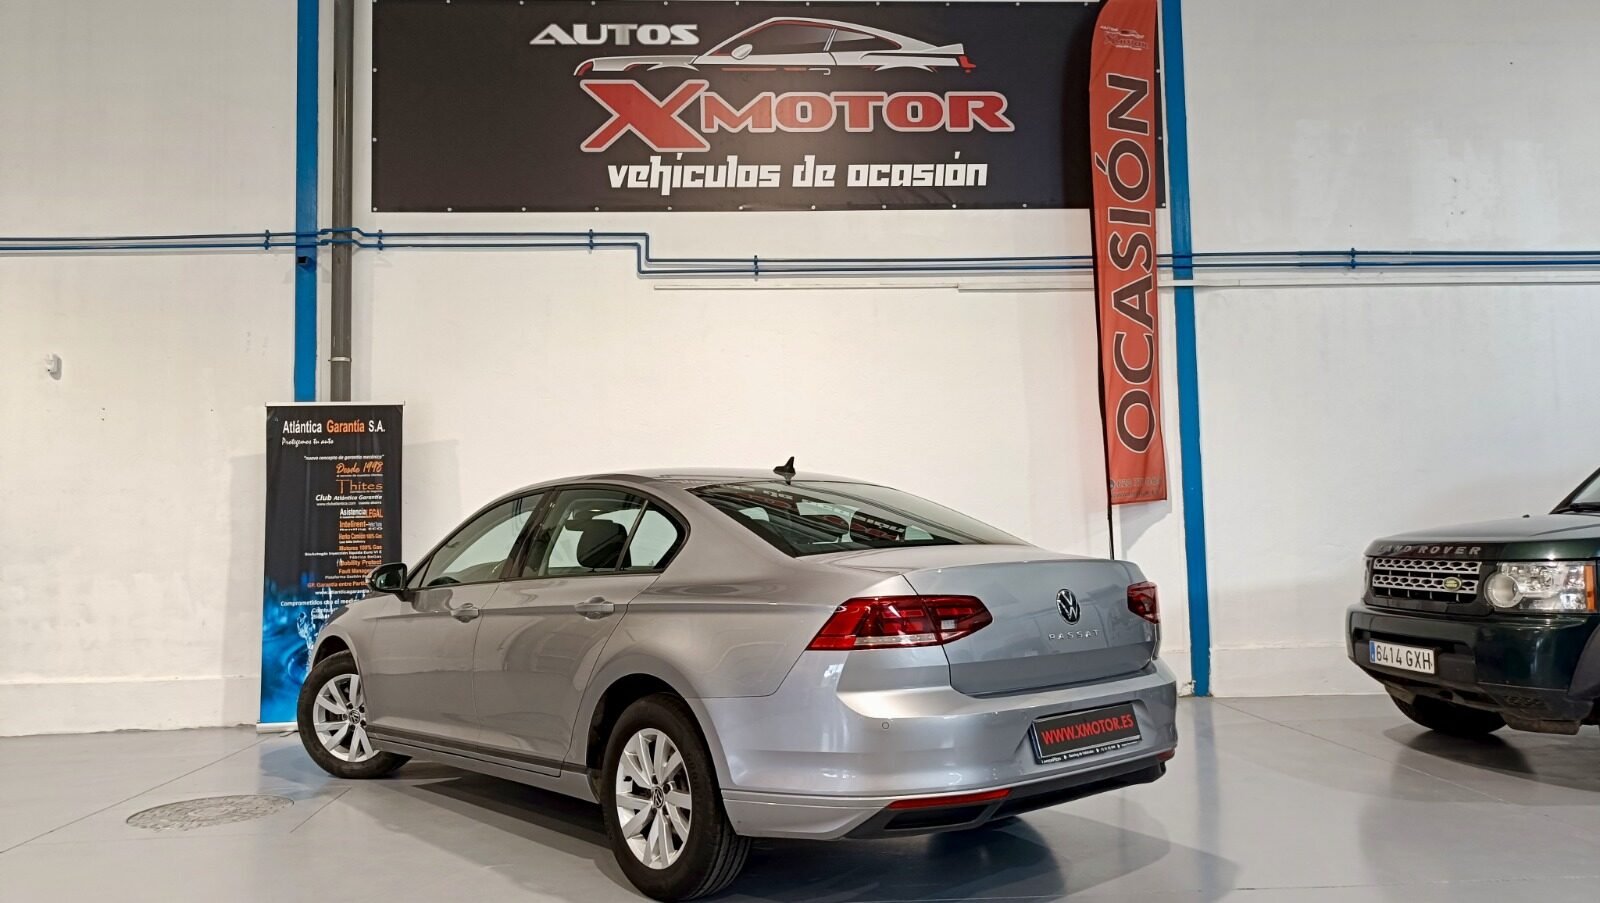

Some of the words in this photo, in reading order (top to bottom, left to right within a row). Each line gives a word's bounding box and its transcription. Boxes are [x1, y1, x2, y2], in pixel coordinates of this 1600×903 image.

[529, 24, 700, 45] AUTOS
[607, 153, 782, 195] vehículos
[792, 155, 836, 187] de
[847, 151, 988, 187] ocasión
[1094, 73, 1157, 455] OCASIÓN
[282, 419, 322, 434] Atlántica
[326, 418, 365, 434] Garantía
[368, 419, 386, 433] S.A.
[336, 462, 361, 474] Desde
[362, 461, 384, 473] 1998
[336, 479, 384, 494] Thites
[315, 494, 332, 502] Club
[1378, 545, 1412, 554] LAND
[1418, 546, 1482, 556] ROVER
[1048, 628, 1100, 641] PASSAT
[1376, 644, 1403, 666] 6414
[1406, 650, 1431, 671] GXH
[1042, 713, 1134, 745] WWW.XMOTOR.ES
